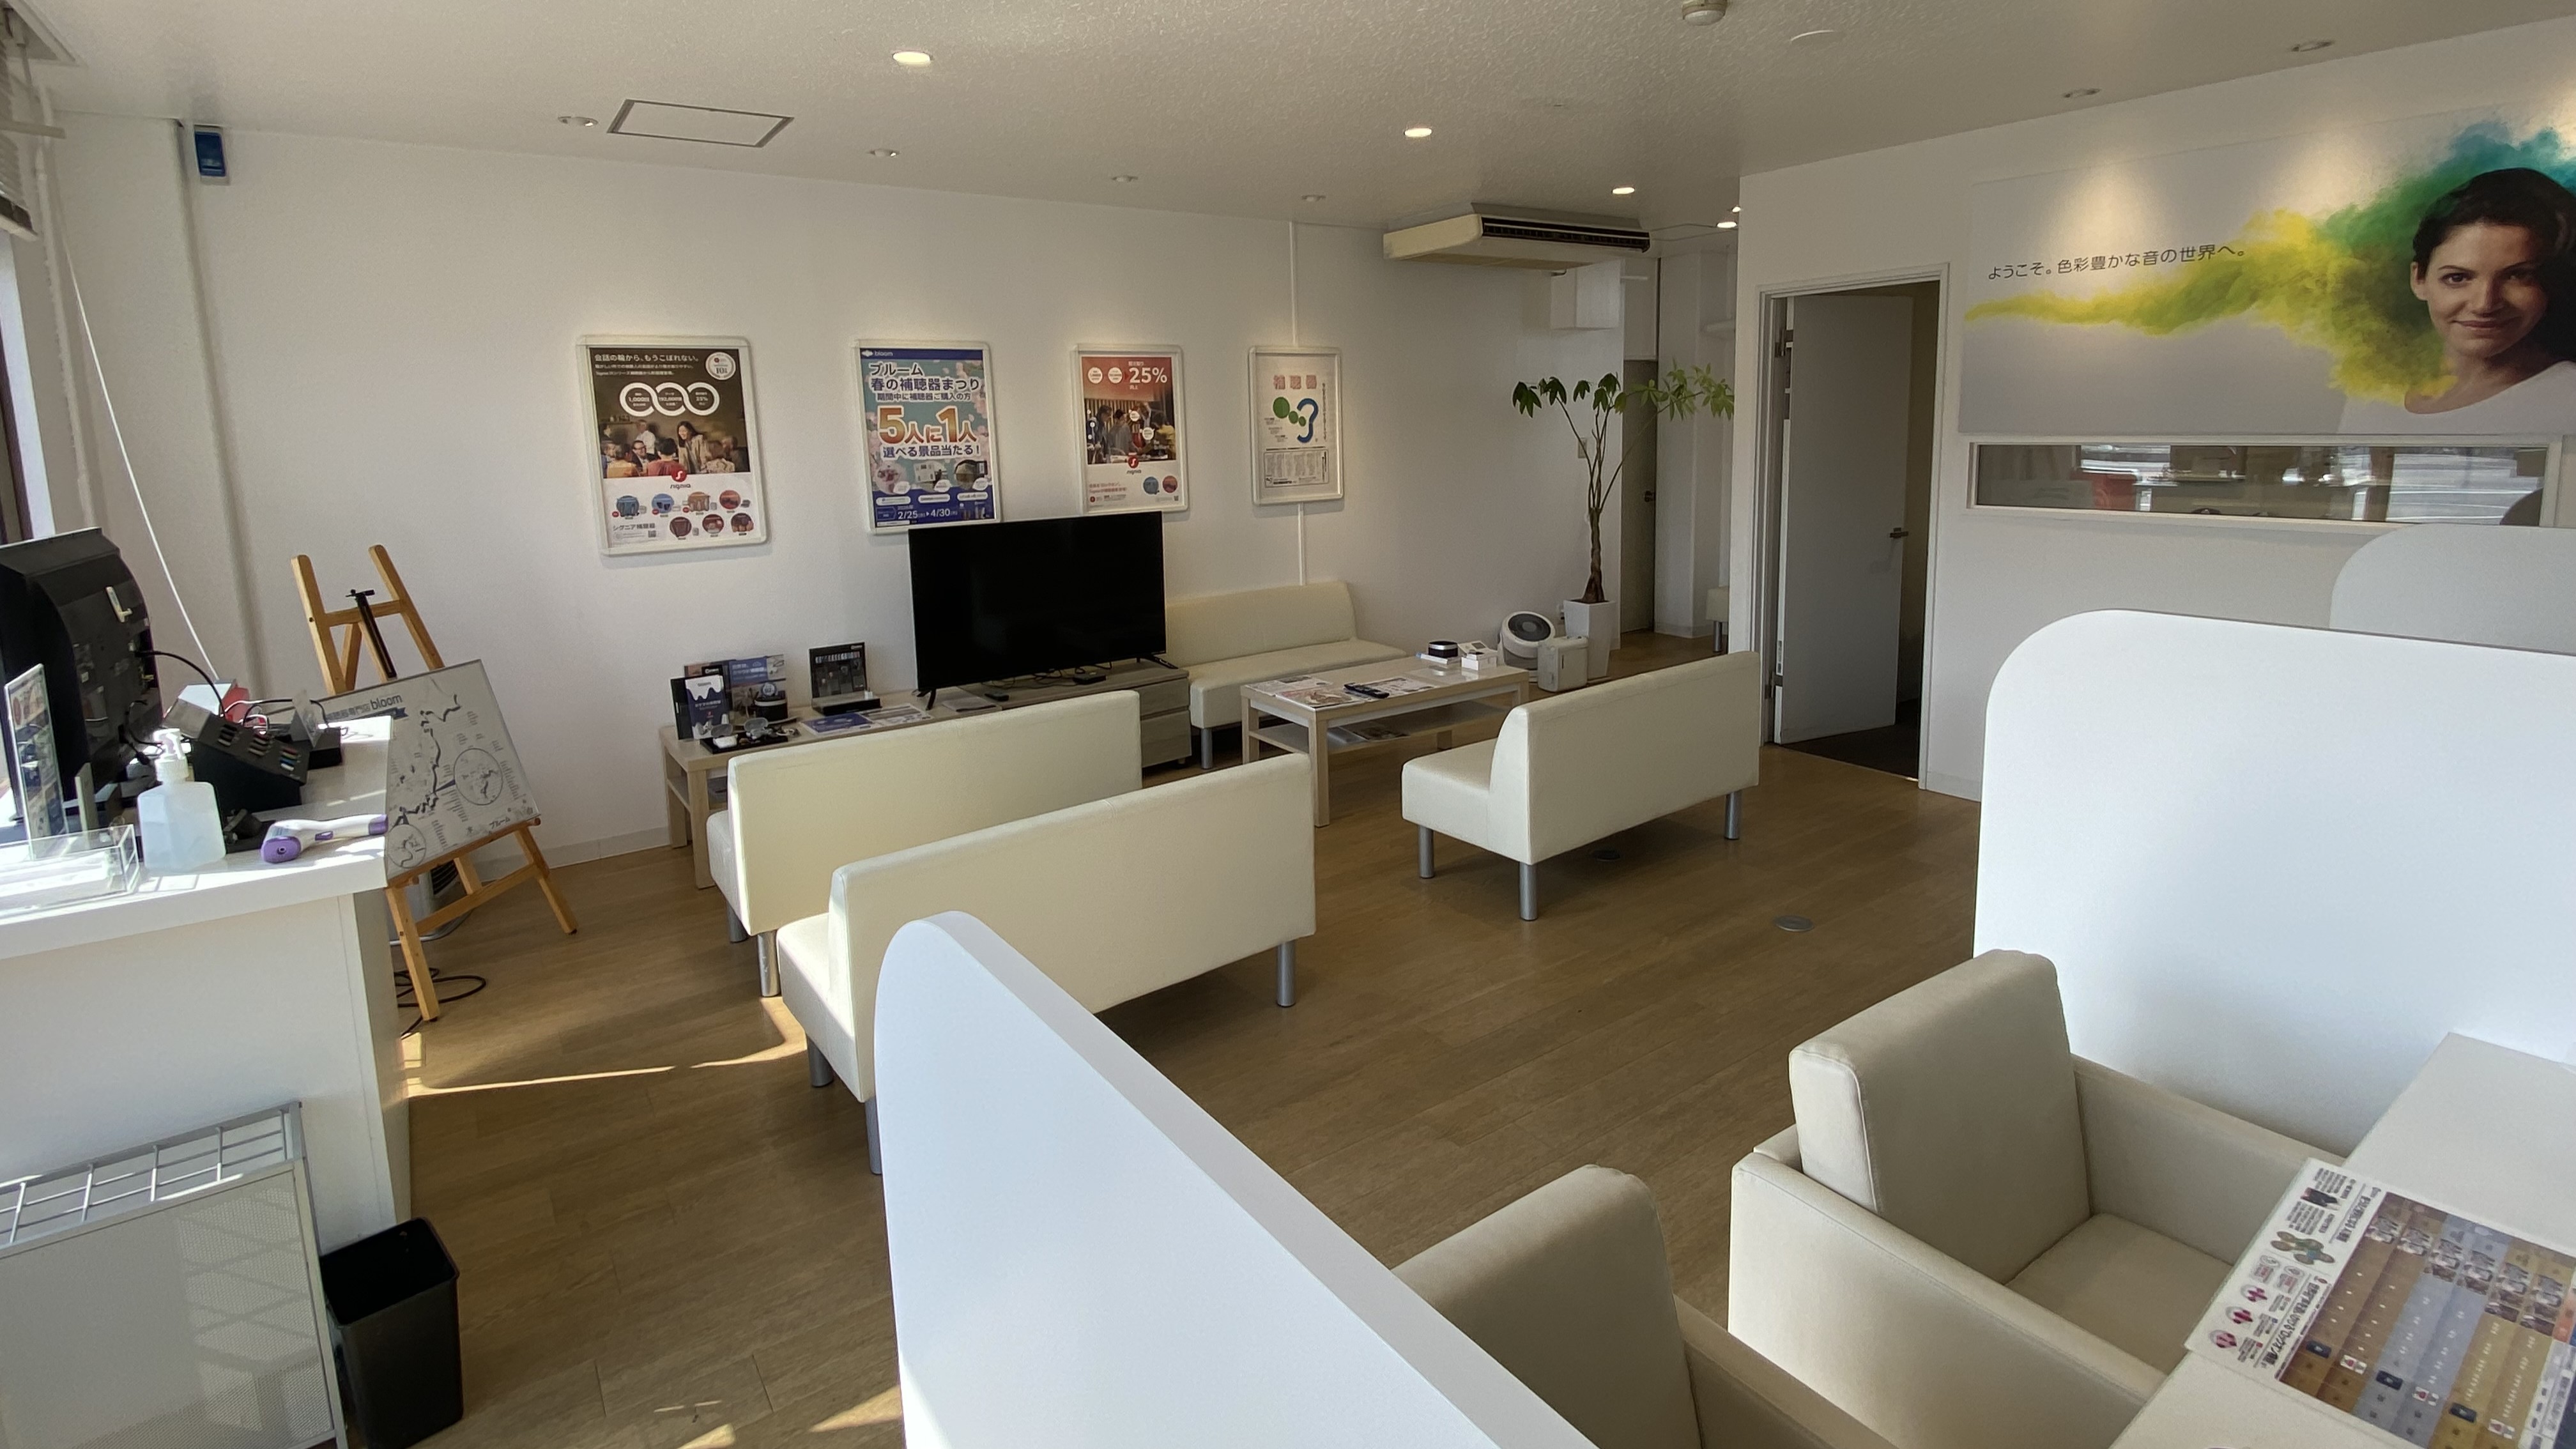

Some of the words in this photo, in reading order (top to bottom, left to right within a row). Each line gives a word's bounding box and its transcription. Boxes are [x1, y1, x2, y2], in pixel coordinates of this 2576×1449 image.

[1988, 244, 2245, 280] ようこそ。色彩豊かな音の世界へ。
[870, 362, 923, 376] ブルーム
[1129, 367, 1168, 383] 25%
[871, 377, 979, 391] 春の補聴器まつり
[877, 392, 971, 401] 期間中に補聴器ご購入の方
[879, 407, 977, 444] 5人に1人
[898, 510, 918, 519] 2/25
[930, 508, 951, 517] 4/30
[371, 694, 402, 710] bloom
